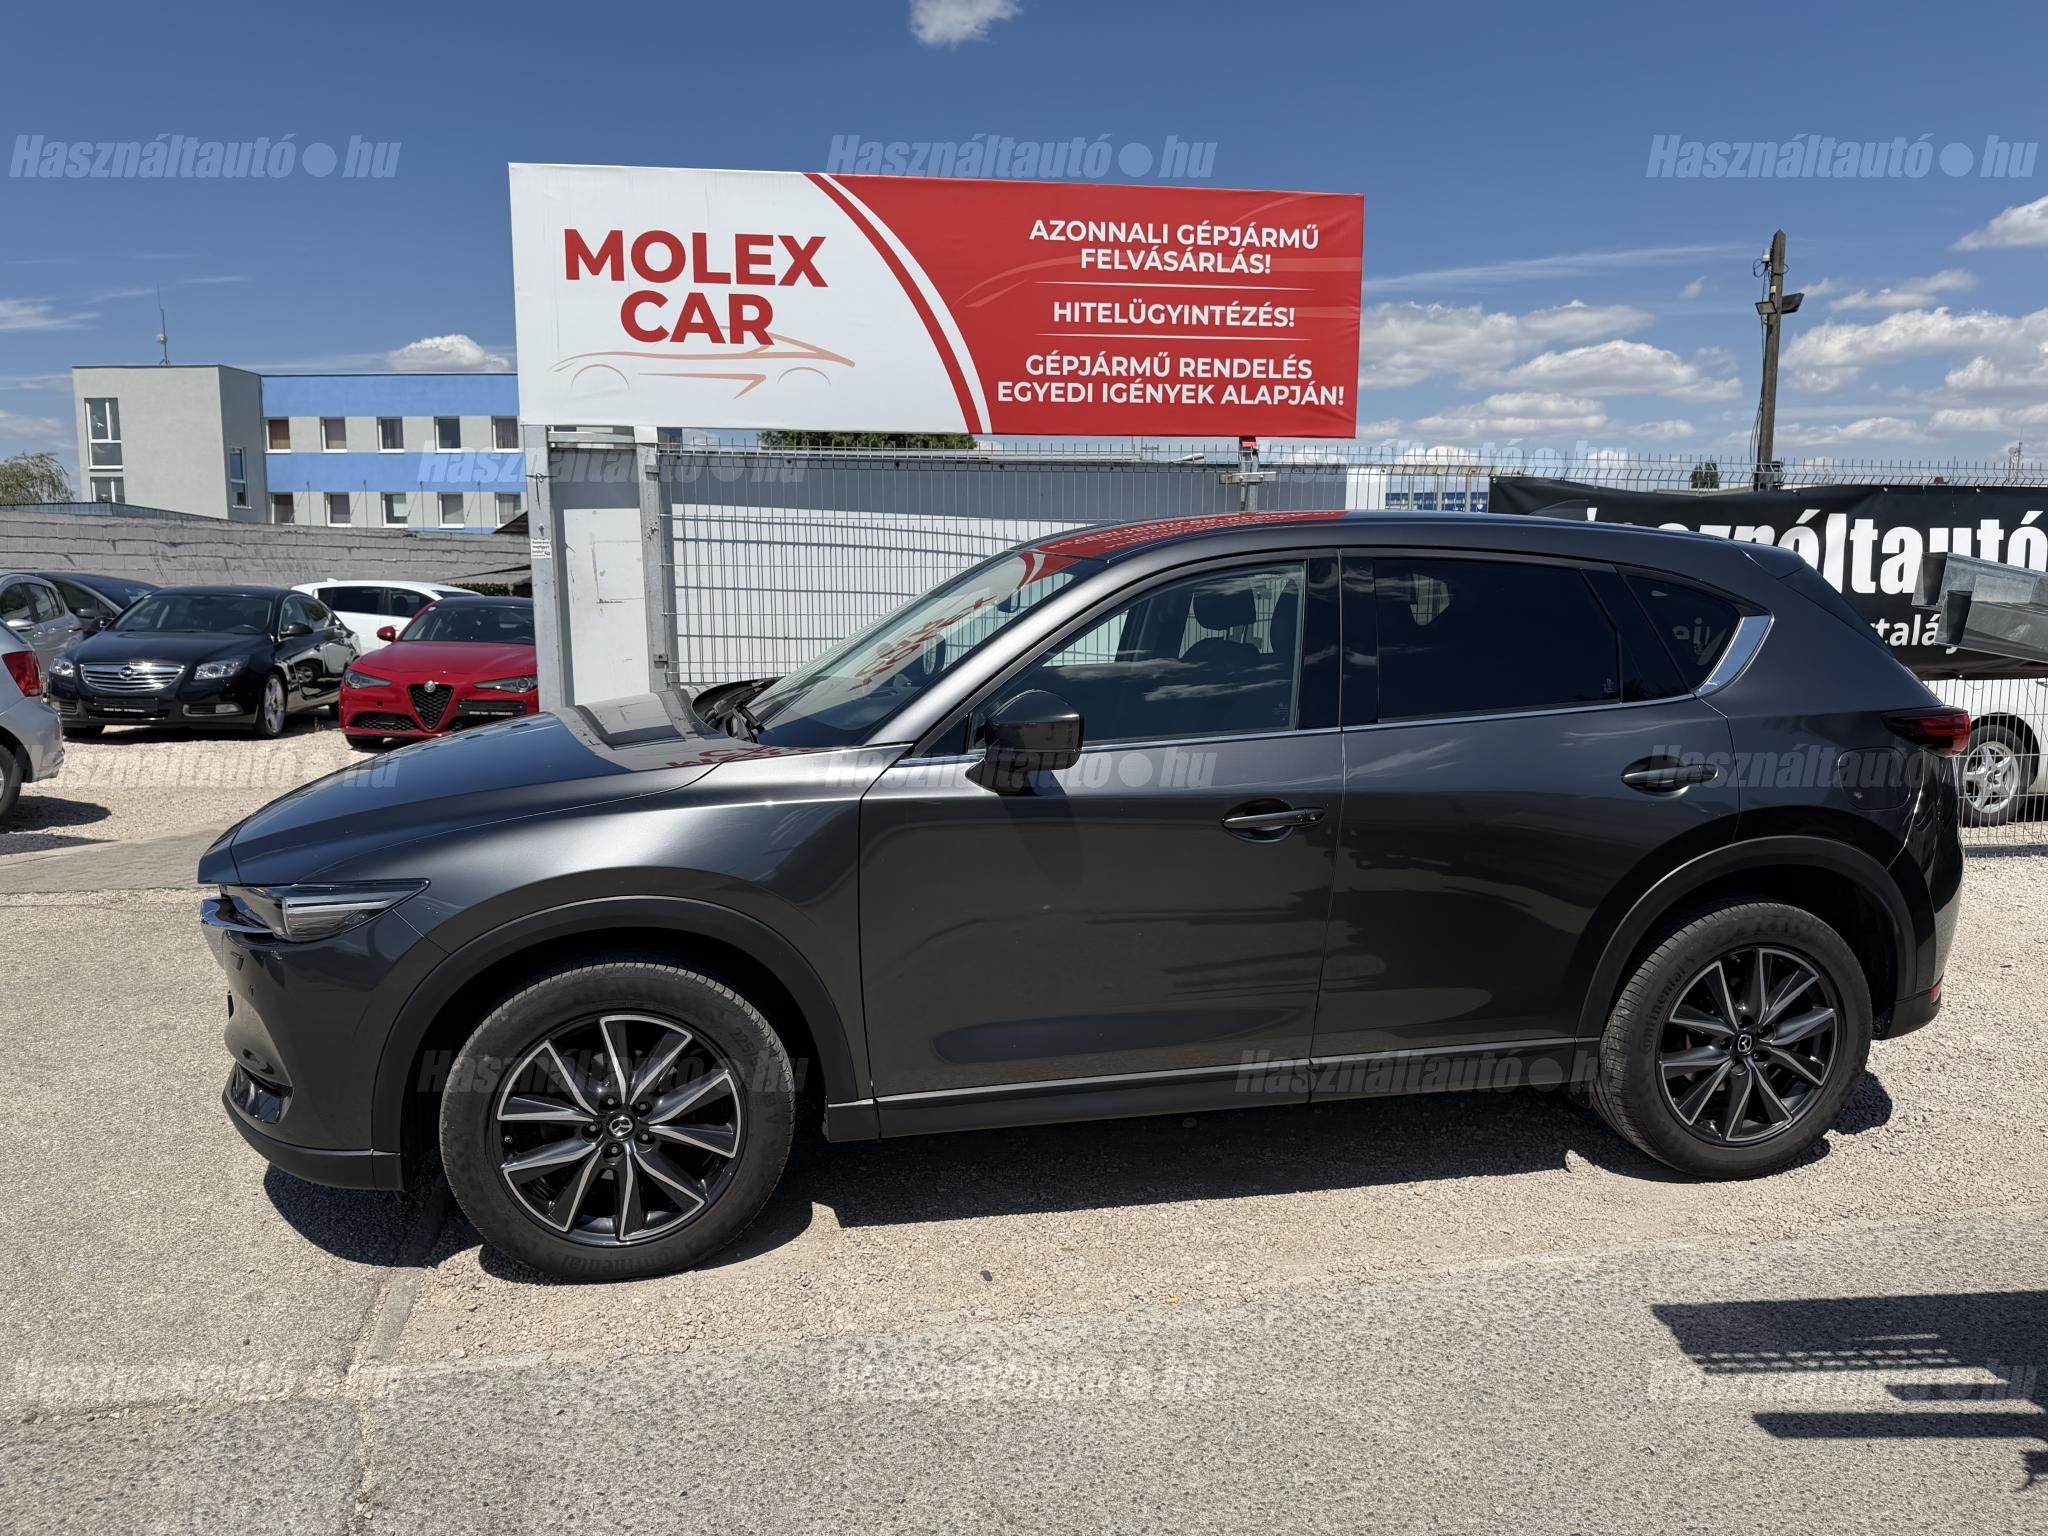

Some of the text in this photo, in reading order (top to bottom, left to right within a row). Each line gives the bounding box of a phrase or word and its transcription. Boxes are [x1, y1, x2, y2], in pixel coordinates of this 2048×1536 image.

[1029, 219, 1319, 249] AZONNALI GÉPJÁRMŰ
[563, 228, 828, 288] MOLEX
[1080, 248, 1271, 275] FELVÁSÁRLÁS!
[620, 290, 774, 346] CAR
[1053, 298, 1296, 328] HITELÜGYINTÉZÉS!
[1025, 351, 1313, 380] GÉPJÁRMŰ RENDELÉS
[997, 379, 1344, 406] EGYEDI IGÉNYEK ALAPJÁN!
